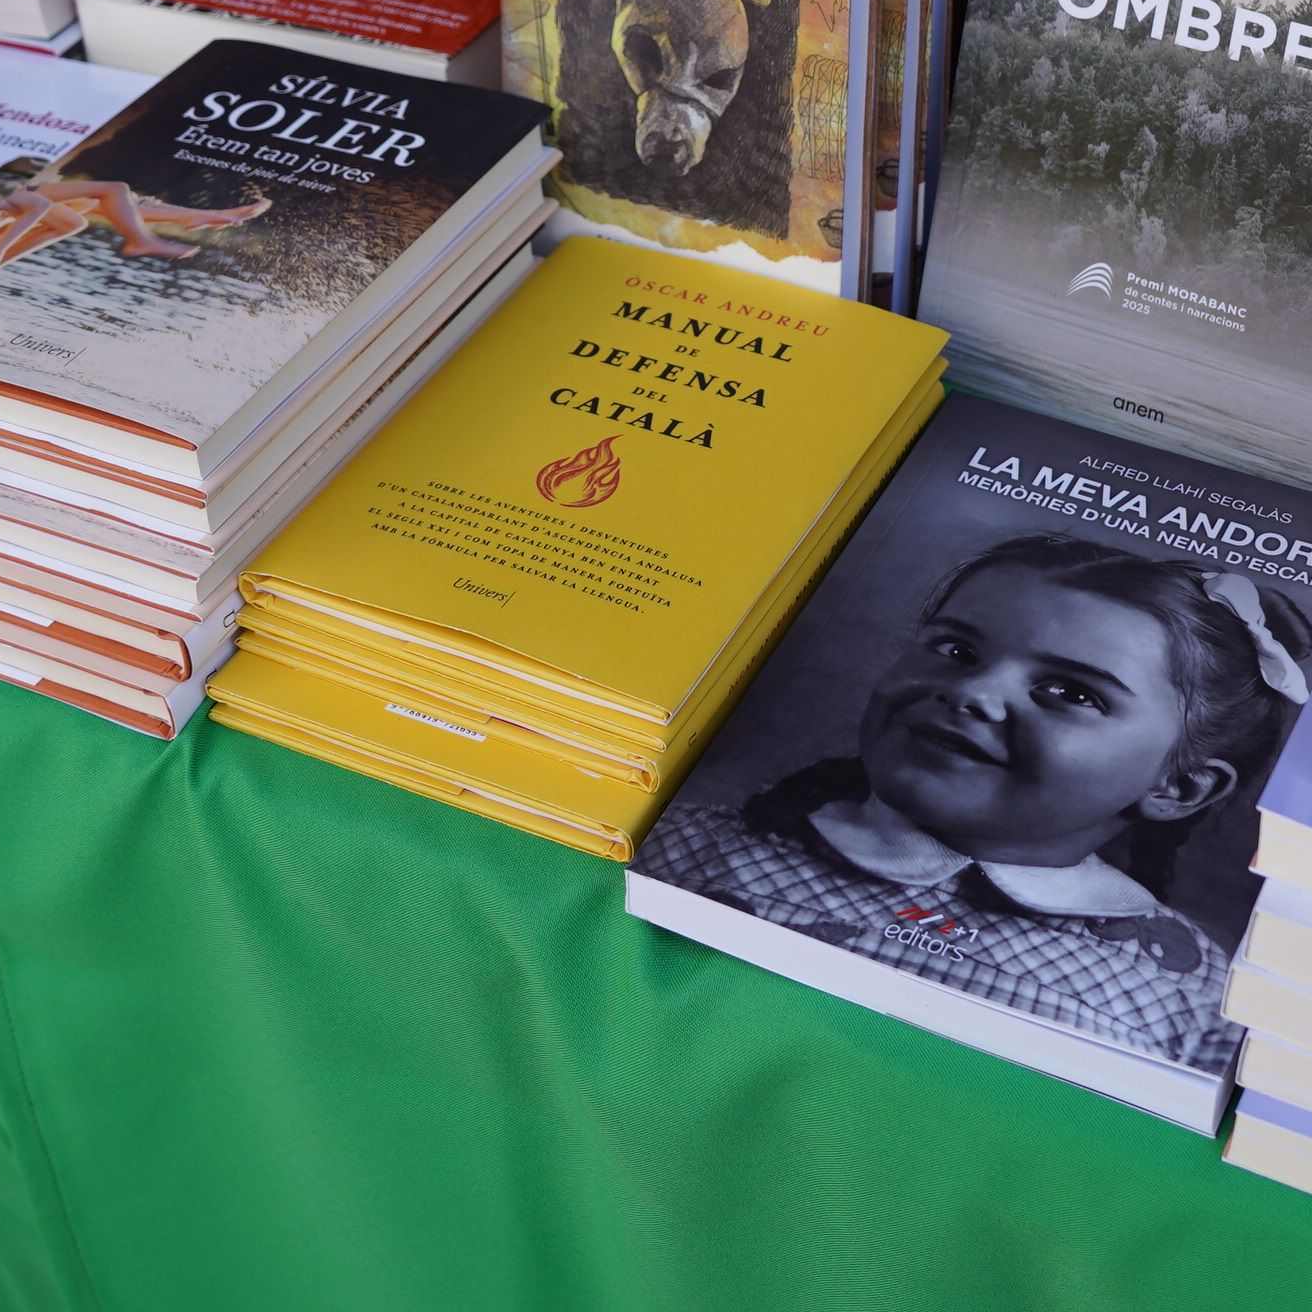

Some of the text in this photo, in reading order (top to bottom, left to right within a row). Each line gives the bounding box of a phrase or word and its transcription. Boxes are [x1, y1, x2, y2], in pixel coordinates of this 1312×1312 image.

[269, 74, 410, 120] SÍLVIA
[175, 124, 376, 184] Érem tan joves
[182, 90, 426, 168] SOLER
[718, 300, 832, 337] ANDREU
[1121, 299, 1151, 316] 2025
[1124, 286, 1139, 297] de
[1141, 291, 1178, 311] contes
[1186, 306, 1246, 332] narracions
[1126, 272, 1248, 318] Premi MORABANC
[612, 300, 795, 363] MANUAL
[674, 344, 701, 358] DE
[569, 338, 767, 409] DEFENSA
[632, 386, 669, 403] DEL
[548, 387, 715, 450] CATALÀ
[1112, 396, 1165, 424] anem
[967, 446, 1021, 481] LA
[1032, 466, 1148, 519] MEVA
[1079, 455, 1294, 525] ALFRED LLAHÍ SEGALÀS
[377, 480, 408, 493] D'UN
[411, 489, 529, 530] CATALANOPARLANT
[636, 559, 704, 587] ANDALUSA
[427, 480, 467, 497] SOBRE
[470, 492, 493, 505] LES
[494, 500, 567, 527] AVENTURES
[579, 525, 670, 560] DESVENTURES
[957, 470, 1078, 517] MEMÒRIES
[1081, 508, 1150, 539] D'UNA
[1156, 530, 1219, 560] NENA
[883, 923, 968, 962] editors
